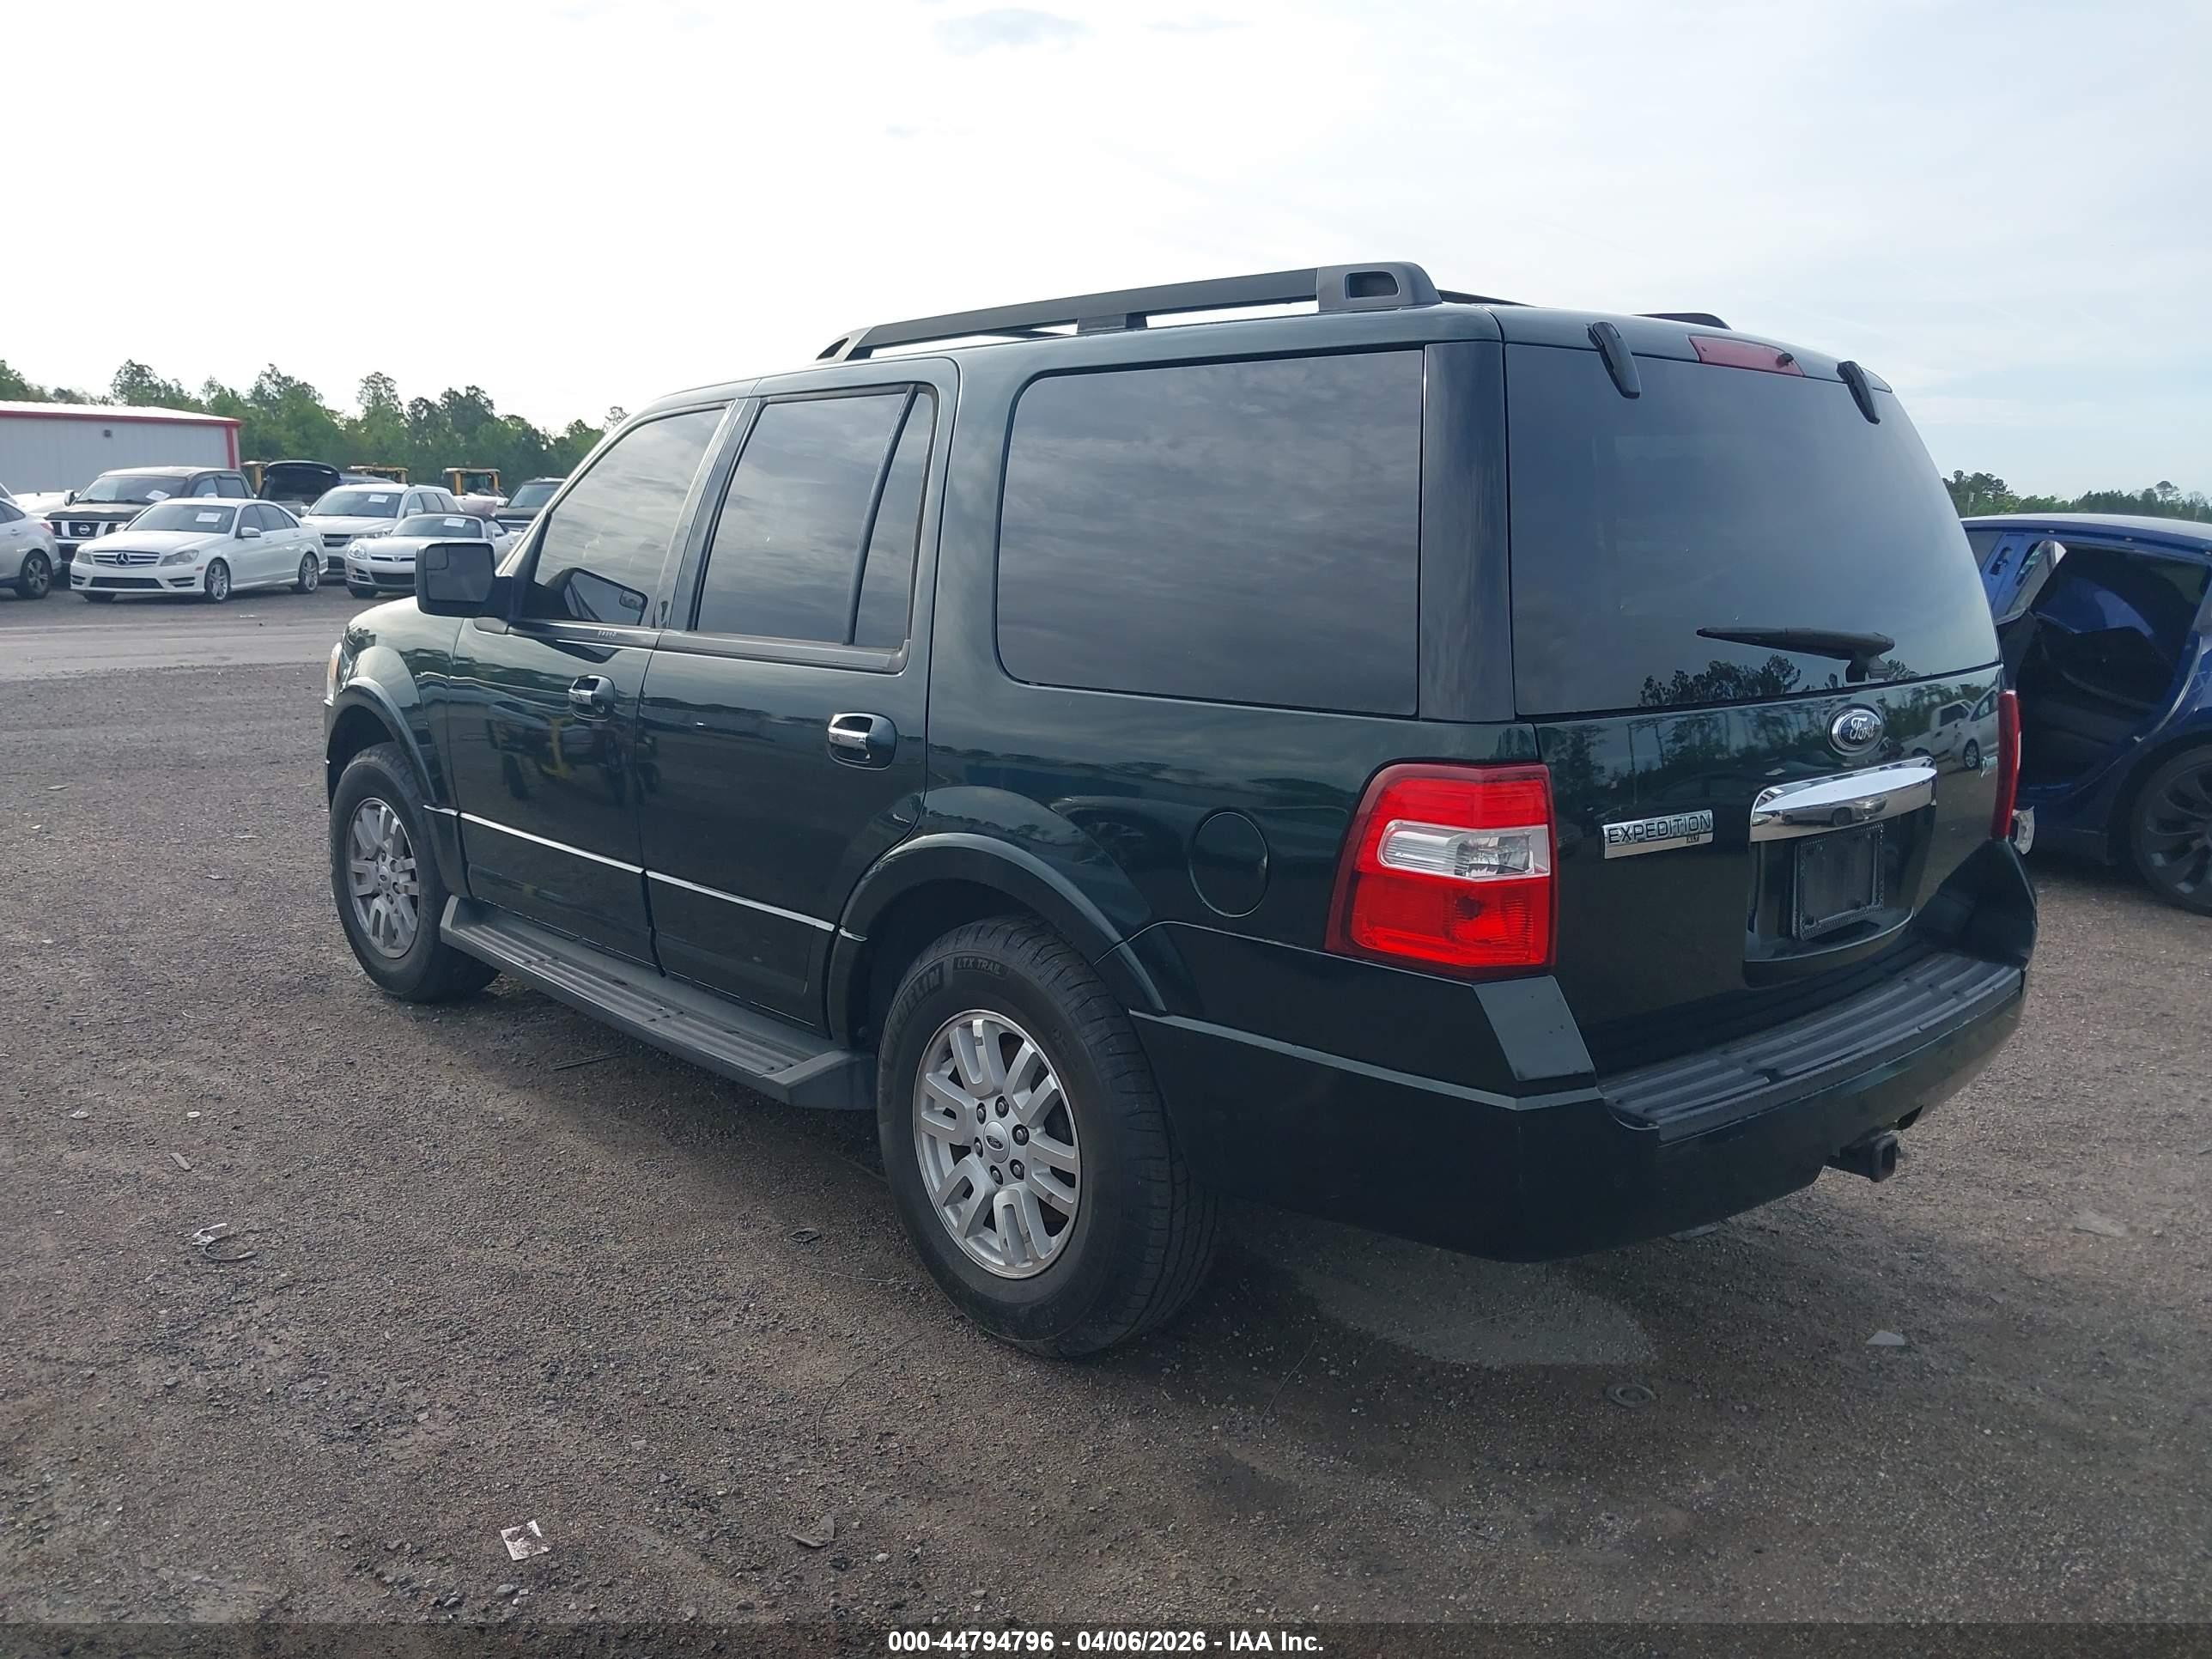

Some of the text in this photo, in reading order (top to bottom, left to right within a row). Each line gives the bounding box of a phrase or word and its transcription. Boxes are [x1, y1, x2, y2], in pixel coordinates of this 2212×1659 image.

[1849, 716, 1875, 741] Ford
[1607, 812, 1711, 844] EXPEDITION
[957, 957, 1001, 975] LTX TRAIL
